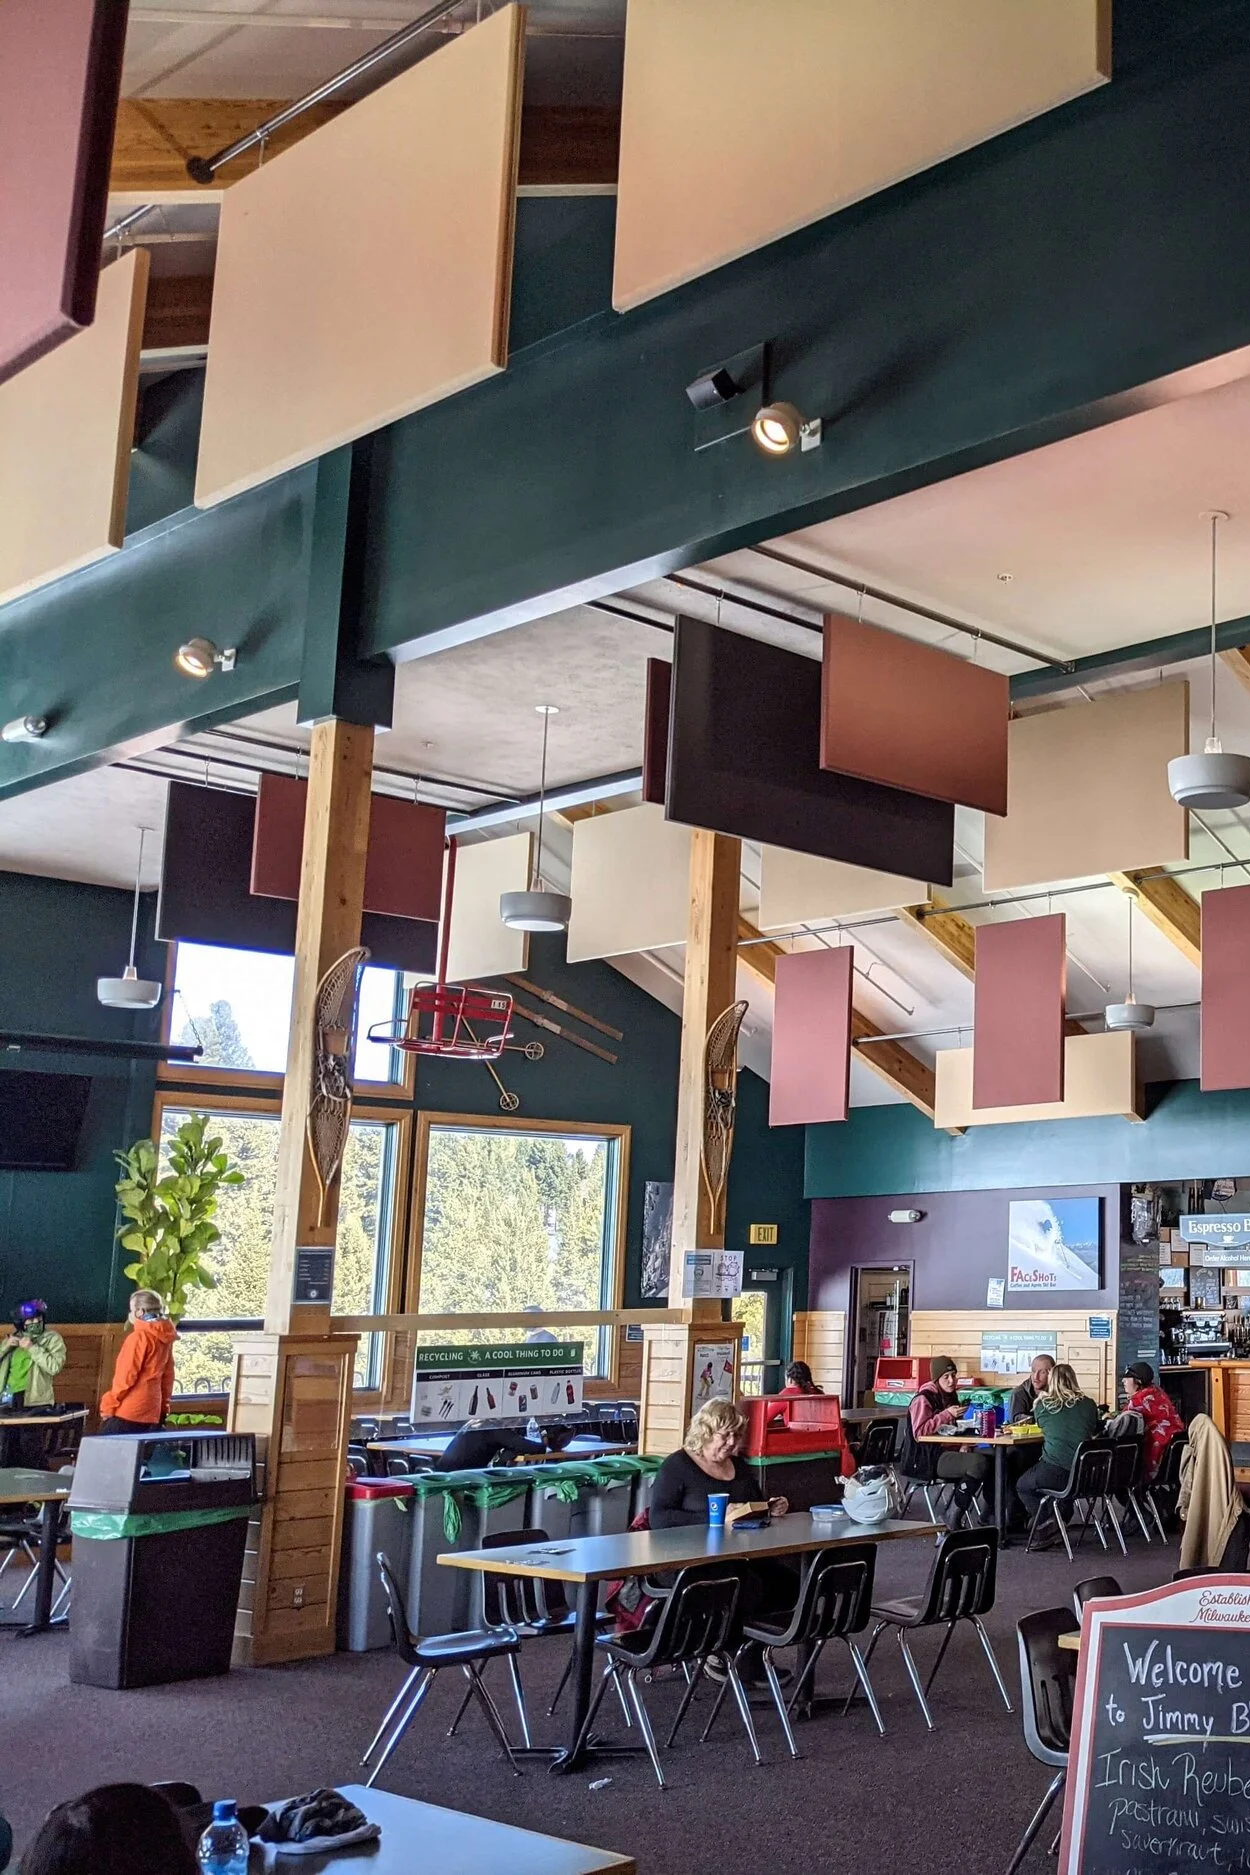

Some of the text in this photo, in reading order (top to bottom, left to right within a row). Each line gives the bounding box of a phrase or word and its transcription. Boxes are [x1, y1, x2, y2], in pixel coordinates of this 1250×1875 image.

[757, 1226, 774, 1242] EXIT
[1188, 1220, 1242, 1235] Espresso
[418, 1352, 464, 1362] RECYCLING
[492, 1350, 513, 1359] COOL
[515, 1348, 539, 1358] THING
[540, 1348, 551, 1357] TO
[552, 1347, 564, 1357] DO
[1123, 1639, 1243, 1694] Welcome
[1105, 1693, 1126, 1726] to
[1141, 1693, 1215, 1751] Jimmy
[1095, 1748, 1170, 1790] Irish
